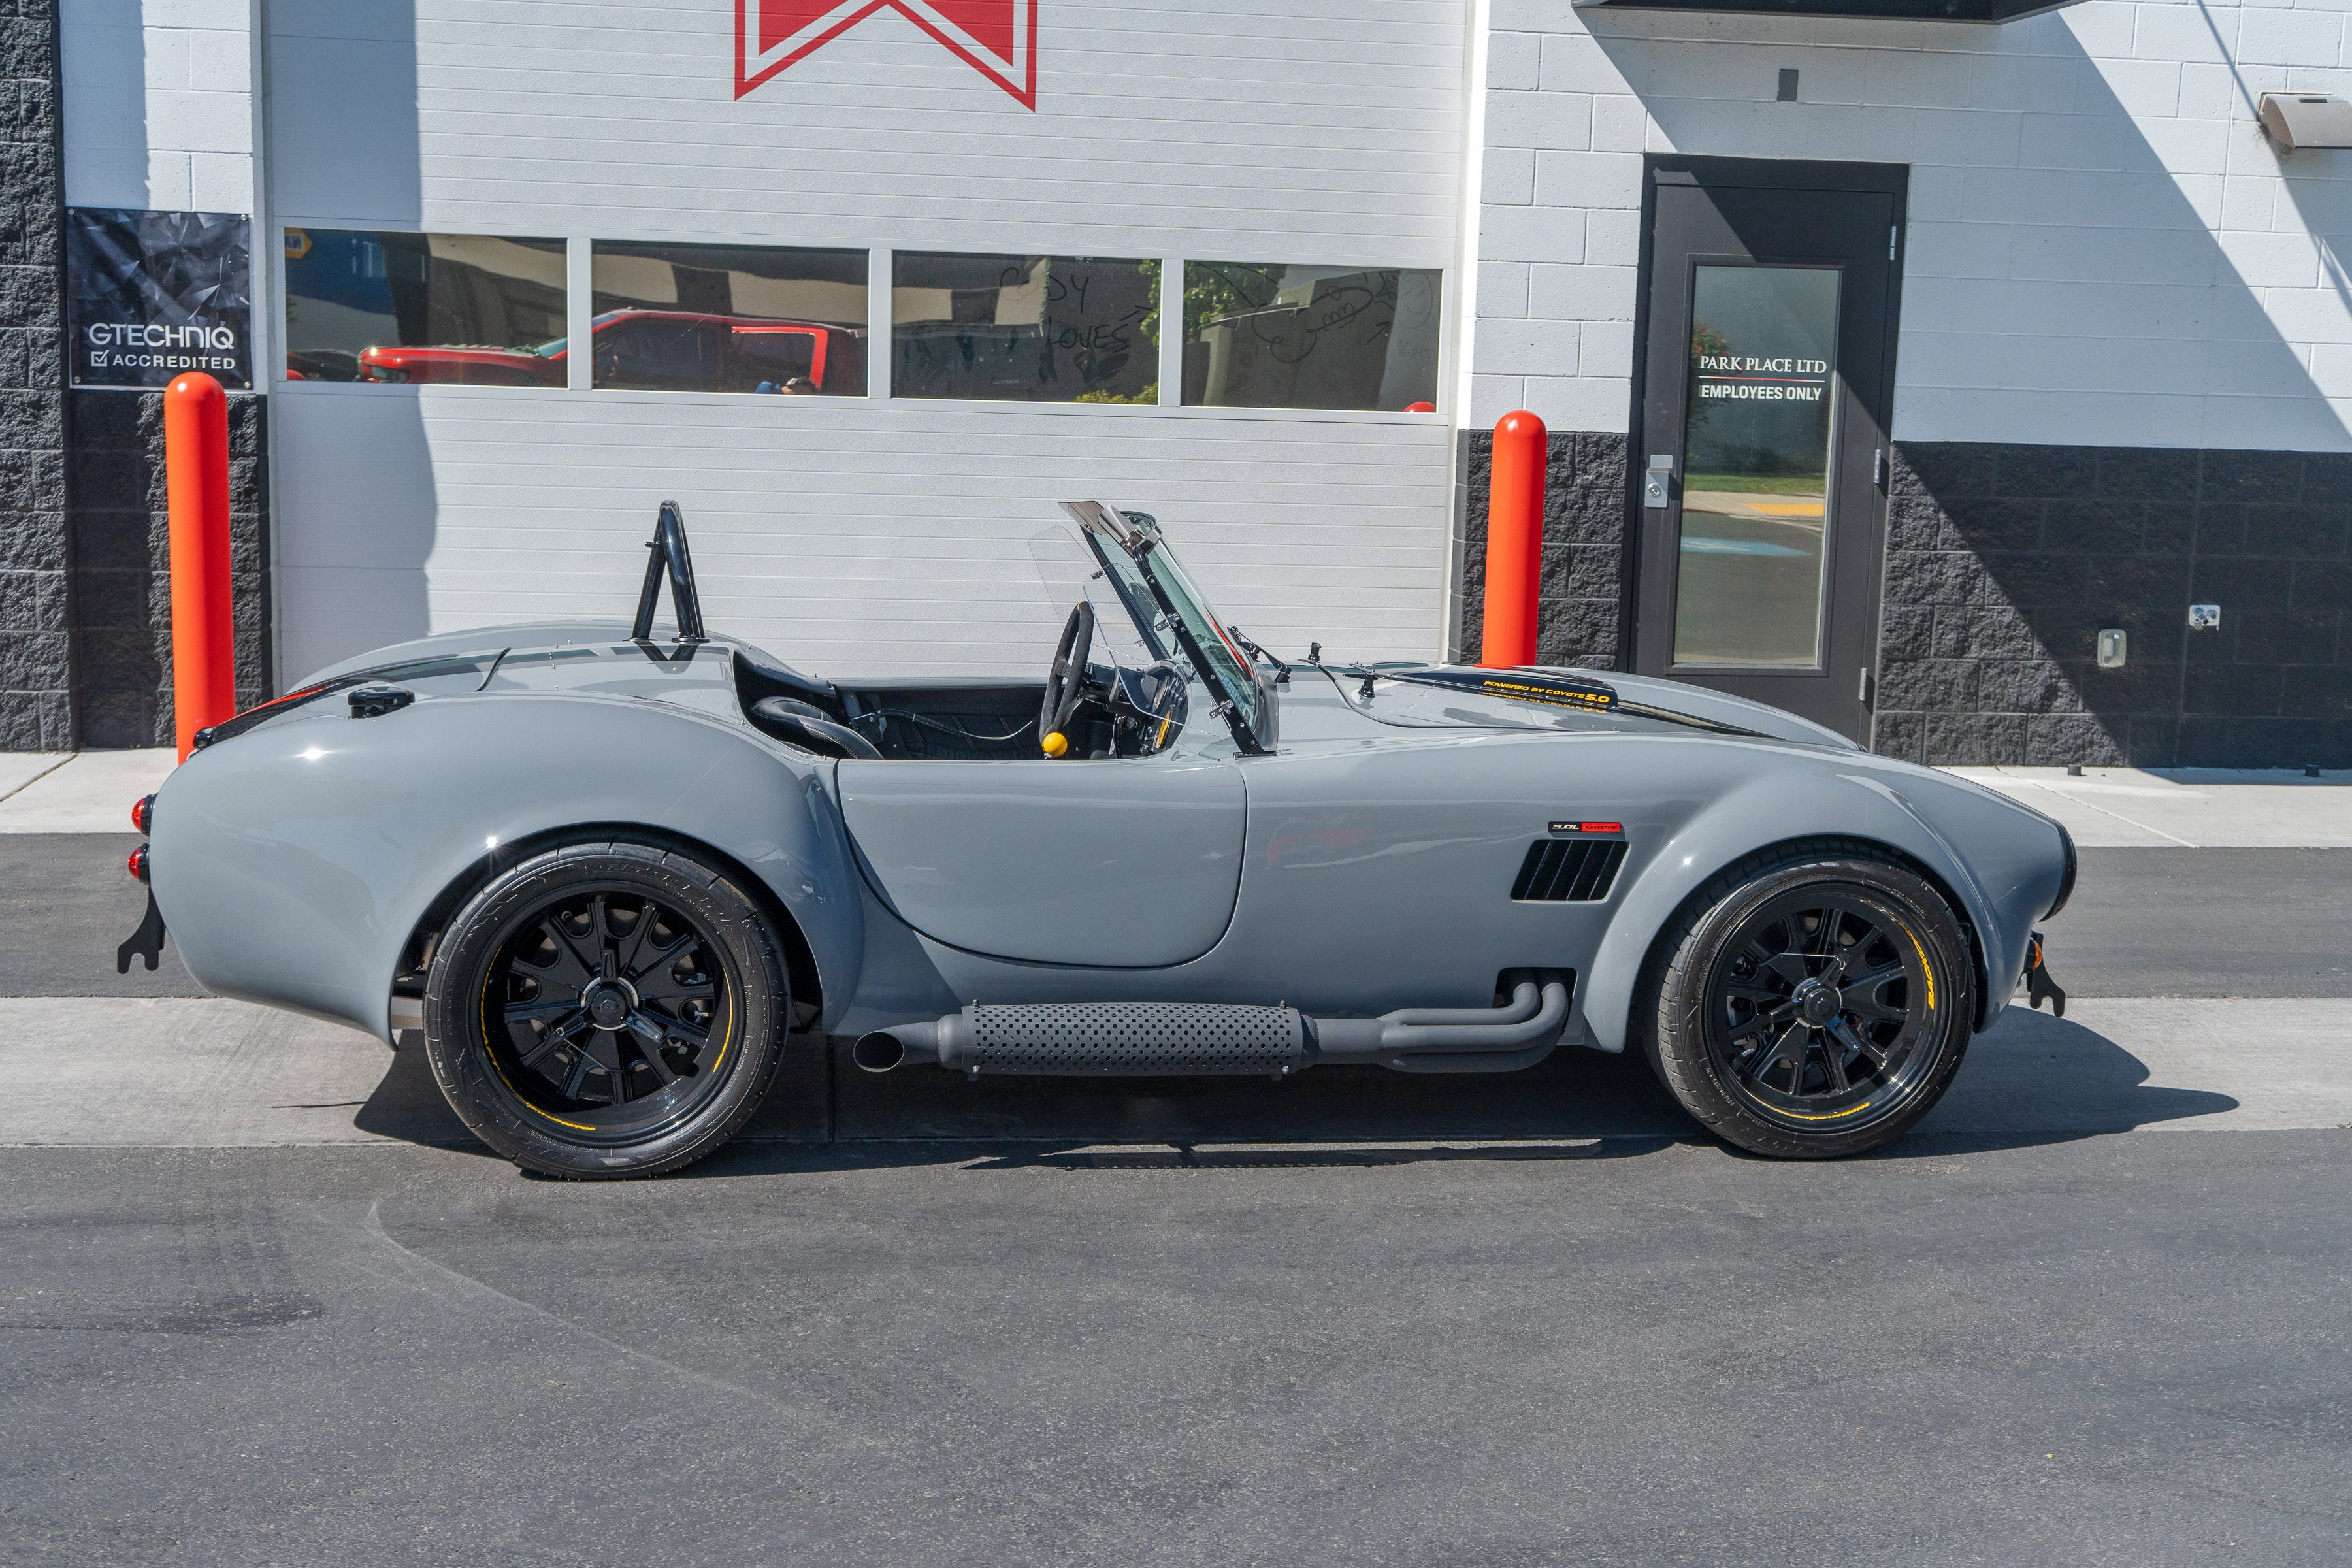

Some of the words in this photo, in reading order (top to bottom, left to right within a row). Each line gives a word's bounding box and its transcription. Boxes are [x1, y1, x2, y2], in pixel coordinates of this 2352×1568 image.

[89, 323, 235, 350] GTECHNIQ
[1047, 315, 1130, 354] LOVES
[112, 354, 235, 370] ACCREDITED
[1700, 356, 1742, 370] PARK
[1746, 357, 1793, 372] PLACE
[1797, 359, 1827, 374] LTD
[1701, 385, 1784, 400] EMPLOYEES
[1786, 387, 1823, 400] ONLY
[1484, 681, 1530, 691] POWERED
[1546, 689, 1585, 698] COYOTE
[1584, 693, 1610, 703] 5.0
